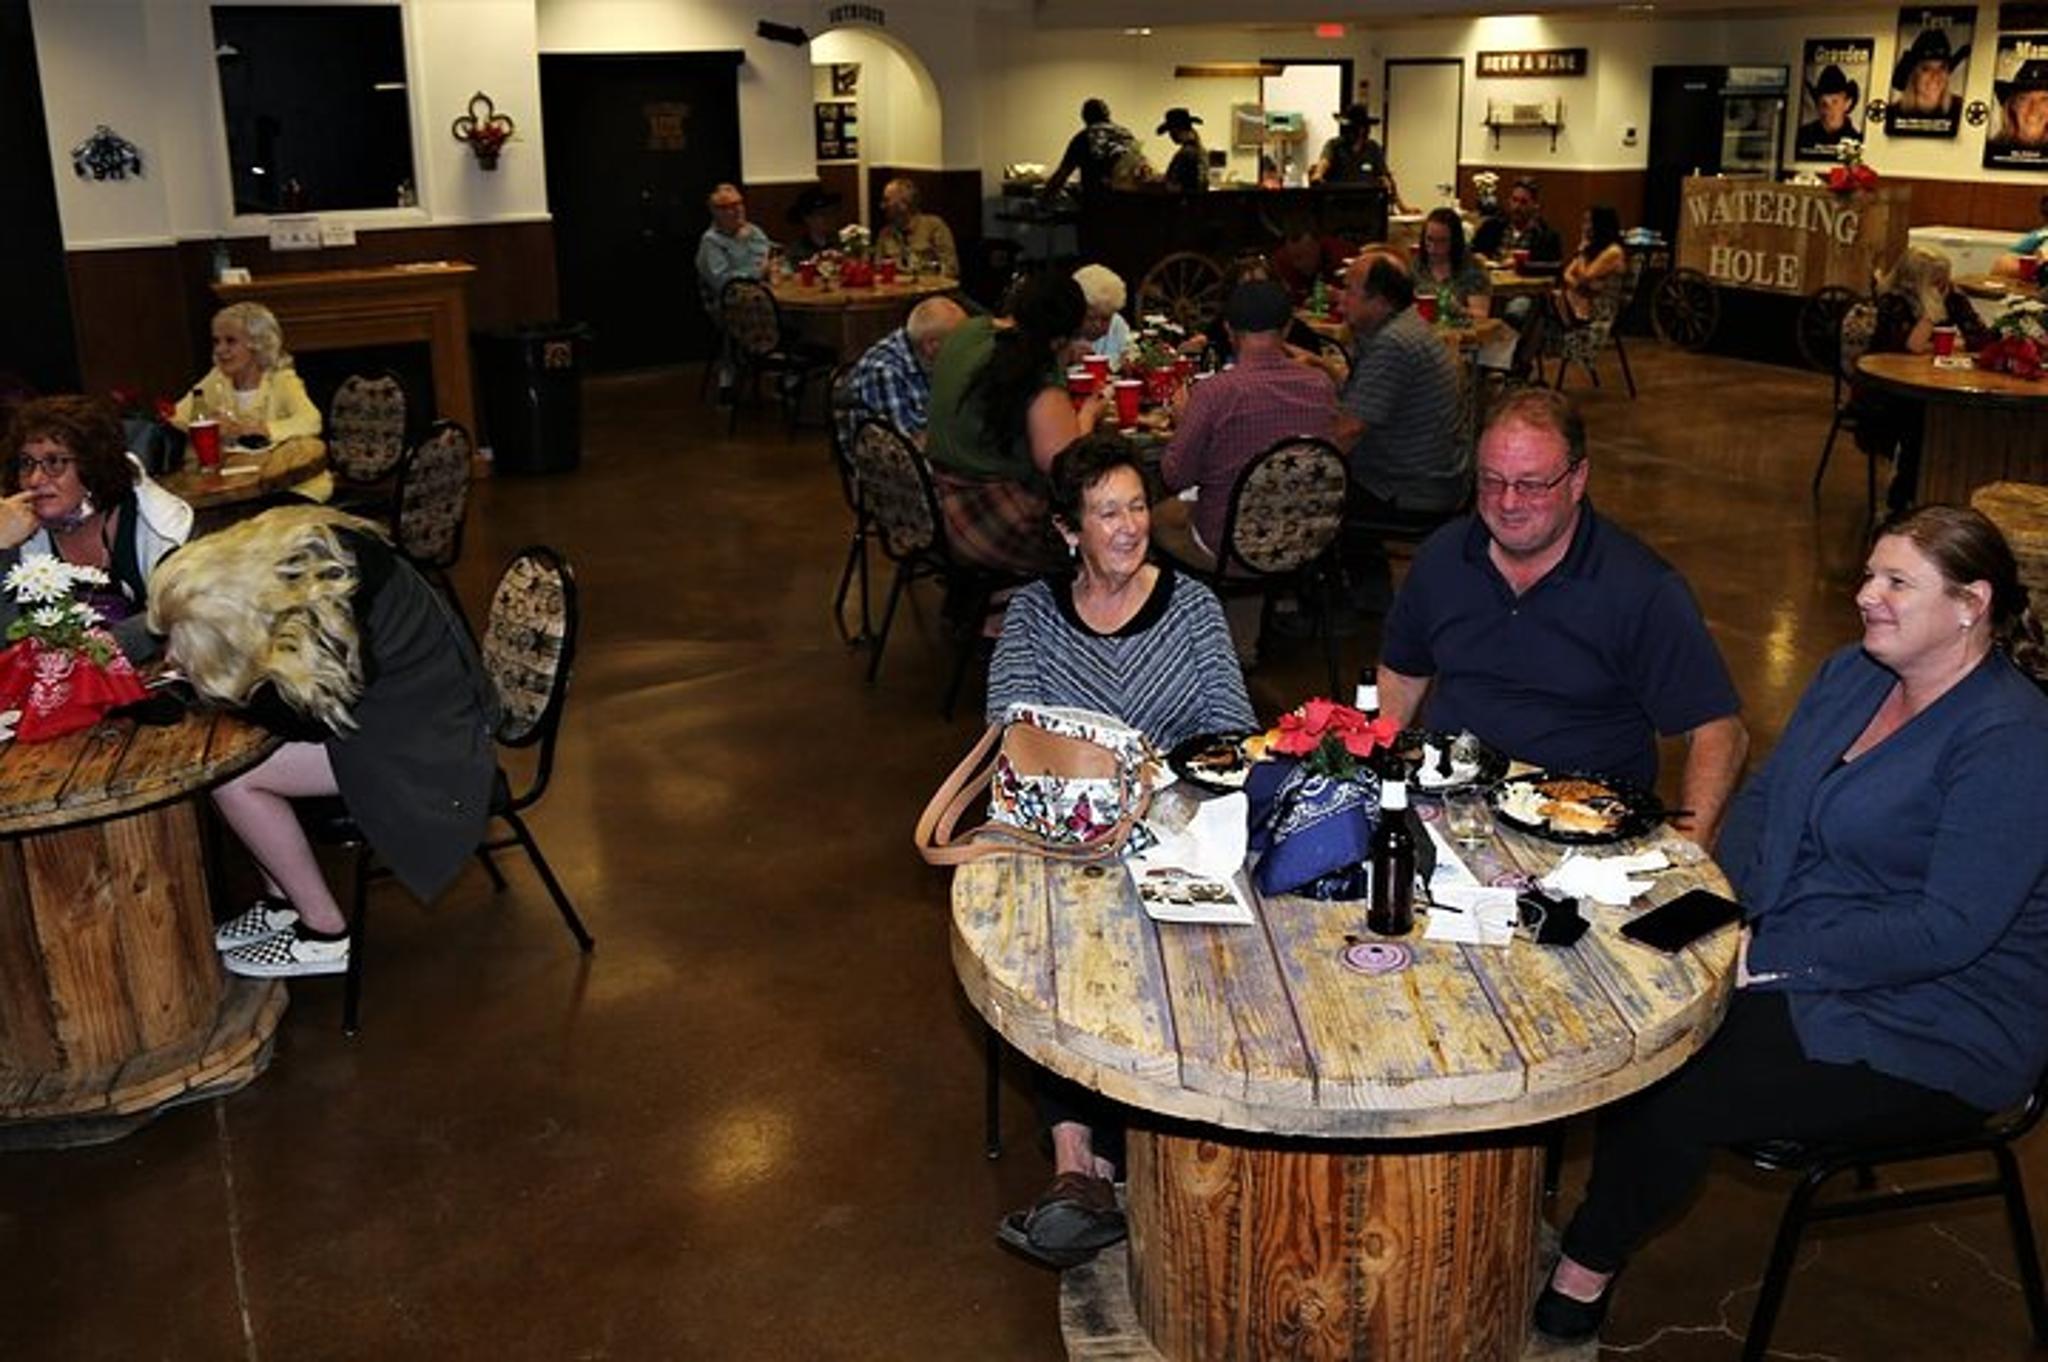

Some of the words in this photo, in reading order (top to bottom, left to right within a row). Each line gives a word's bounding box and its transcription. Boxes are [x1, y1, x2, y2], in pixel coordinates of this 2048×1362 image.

[1482, 55, 1519, 72] BEER
[1686, 189, 1859, 245] WATERING
[1709, 244, 1799, 288] HOLE
